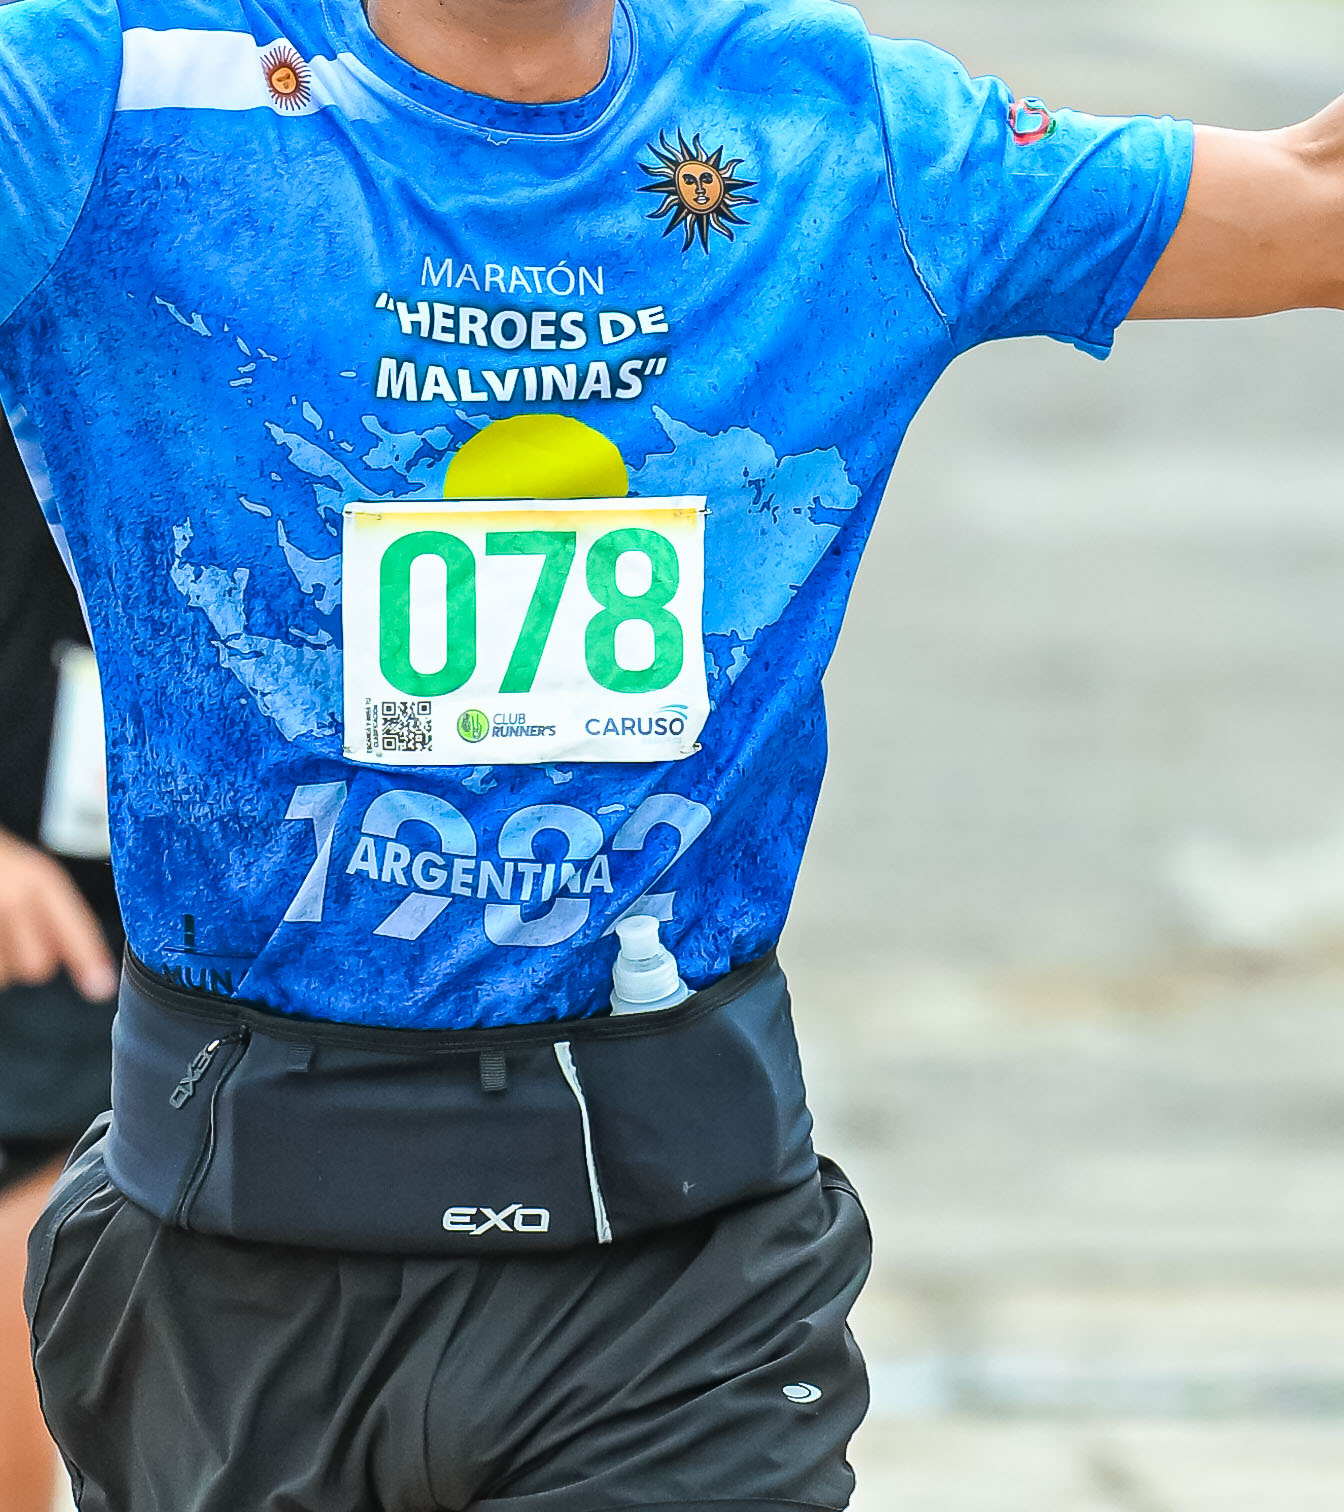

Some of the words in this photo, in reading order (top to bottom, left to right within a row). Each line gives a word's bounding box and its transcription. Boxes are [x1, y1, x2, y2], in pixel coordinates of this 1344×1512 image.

[421, 256, 604, 296] MARATÓN
[599, 305, 669, 345] DE
[379, 528, 684, 698] 078
[492, 725, 556, 737] RUNNER'S
[493, 712, 526, 725] CLUB
[585, 717, 685, 736] CARUSO
[284, 780, 712, 947] 1982
[345, 836, 614, 902] ARGENTINA
[442, 1203, 550, 1236] EXO
